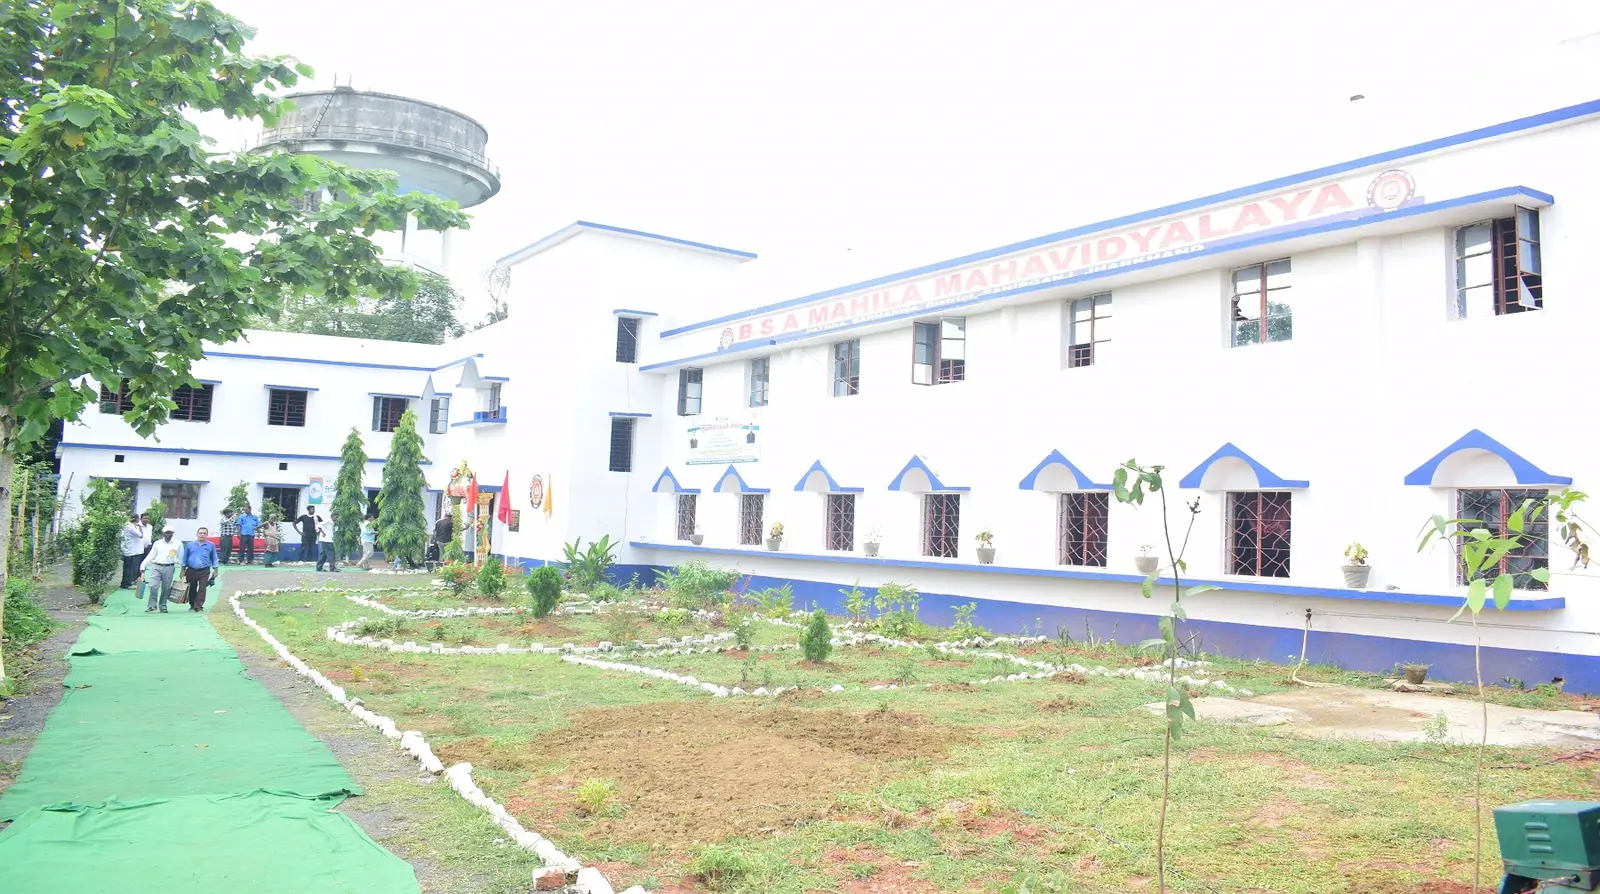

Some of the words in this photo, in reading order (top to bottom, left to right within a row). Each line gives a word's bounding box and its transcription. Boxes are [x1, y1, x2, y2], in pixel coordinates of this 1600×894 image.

[738, 323, 753, 340] B
[760, 318, 774, 336] S
[783, 314, 800, 331] A
[808, 284, 922, 326] MAHILA
[935, 183, 1354, 298] MAHAVIDYALAYA
[1084, 244, 1205, 275] JHARKHAND
